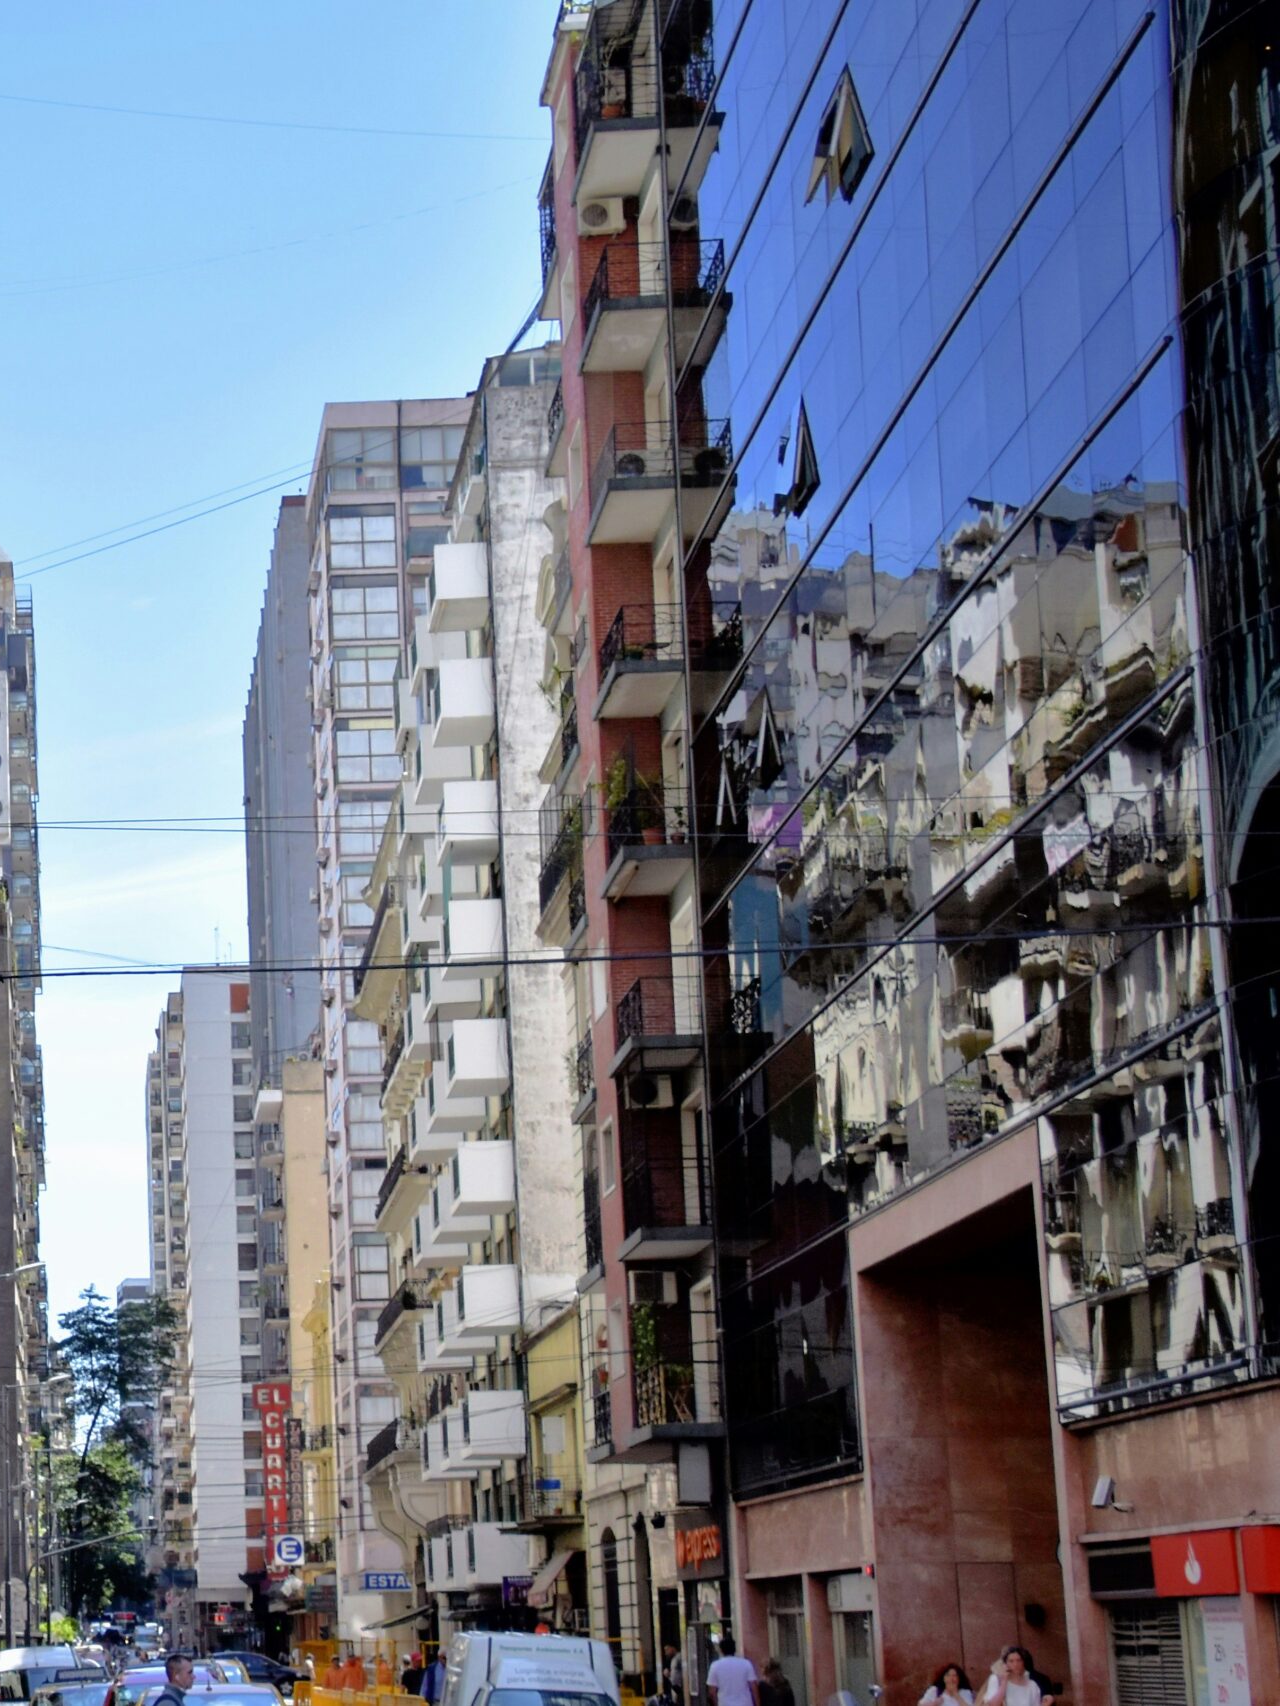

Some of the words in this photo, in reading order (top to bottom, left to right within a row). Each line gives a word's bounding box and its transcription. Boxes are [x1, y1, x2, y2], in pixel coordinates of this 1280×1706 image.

[256, 1388, 286, 1405] EL
[265, 1412, 286, 1574] CUARTIO
[281, 1541, 298, 1559] E
[368, 1575, 411, 1588] ESTA
